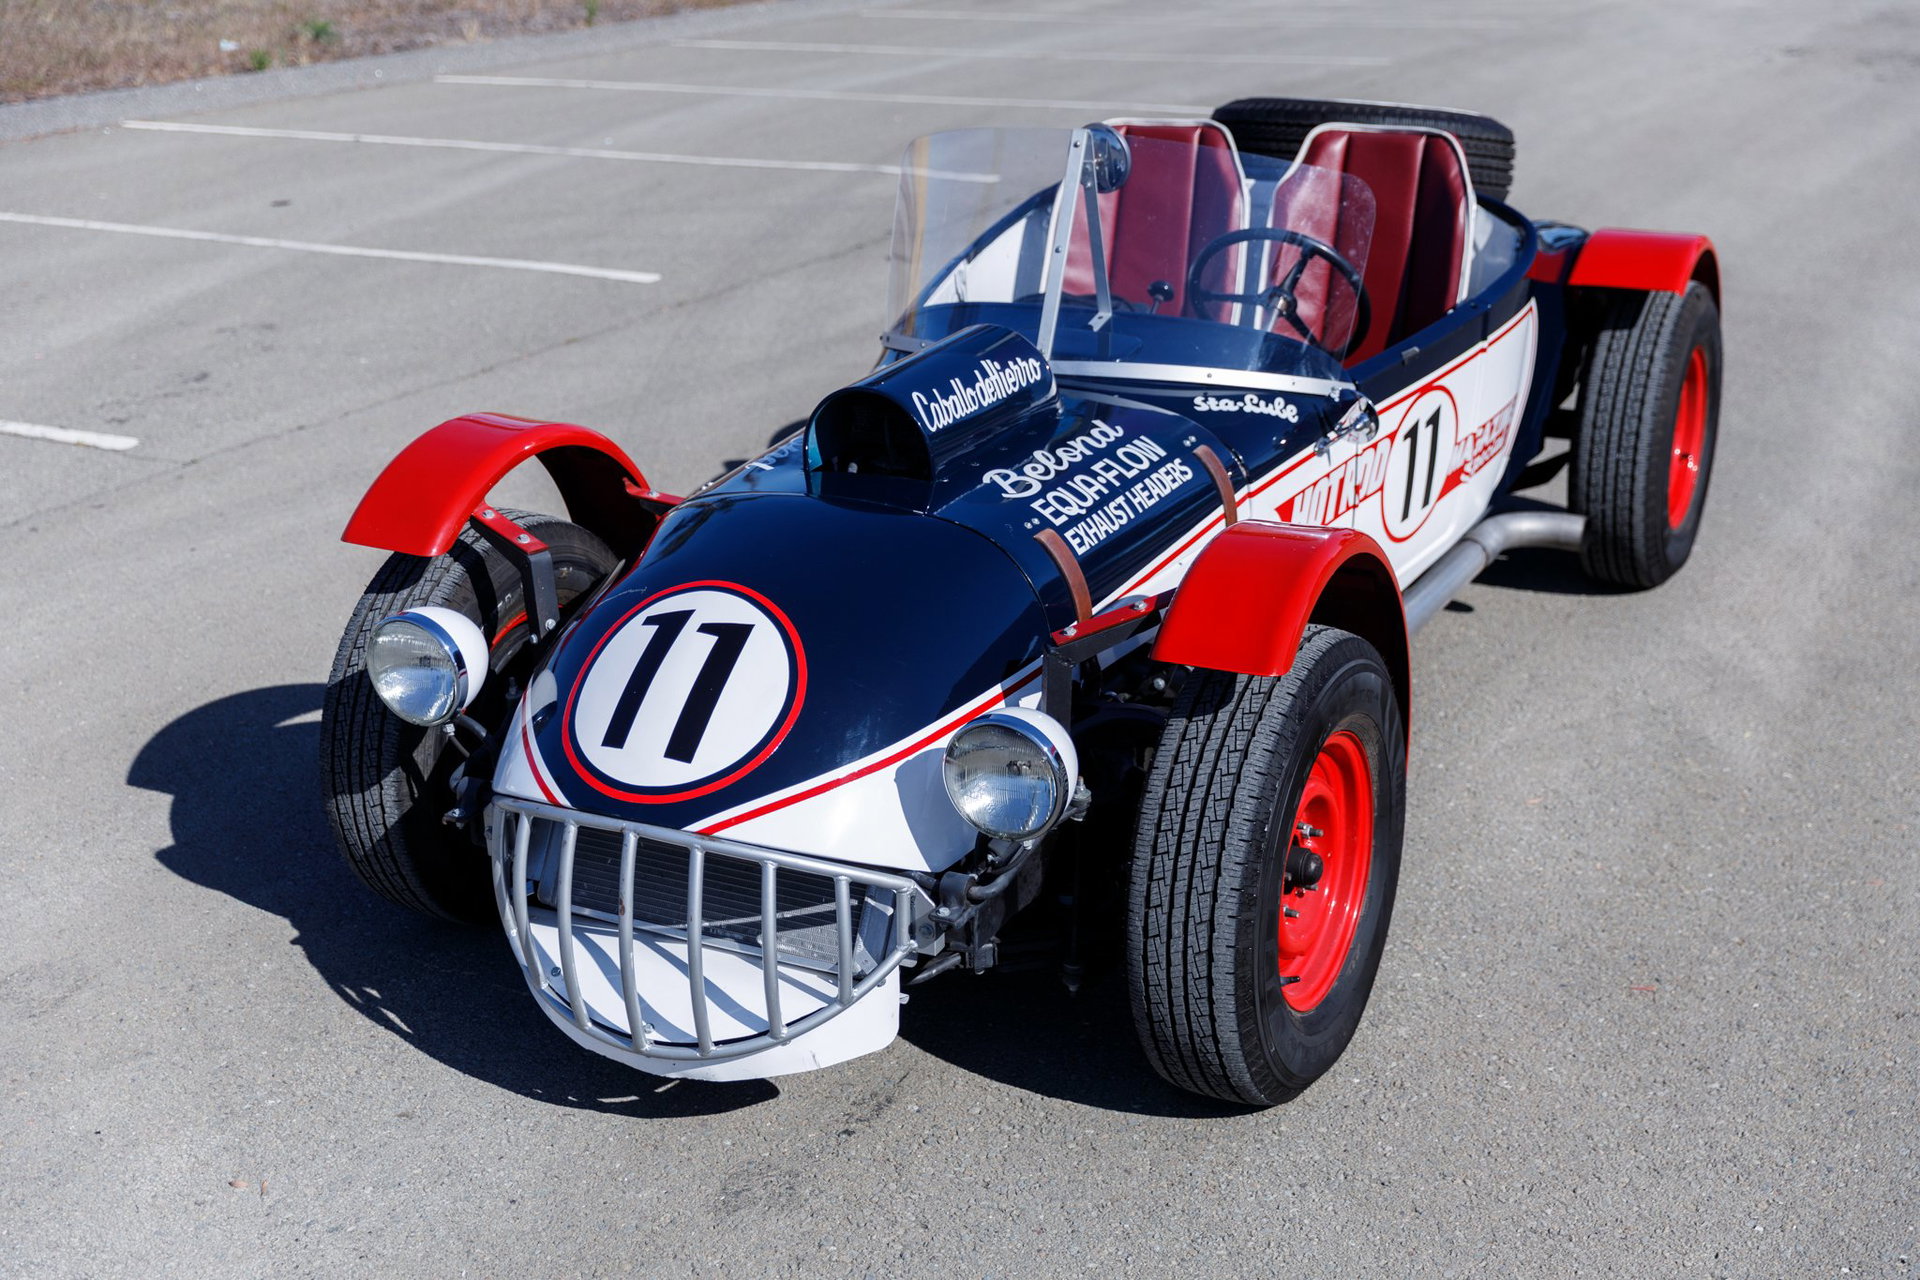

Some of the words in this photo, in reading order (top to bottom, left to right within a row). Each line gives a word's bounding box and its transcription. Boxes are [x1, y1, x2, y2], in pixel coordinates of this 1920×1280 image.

[1193, 394, 1299, 423] Sta-Lube
[982, 419, 1124, 498] Belond
[1064, 496, 1136, 556] EXHAUST
[1125, 457, 1194, 514] HEADERS
[1400, 404, 1442, 523] 11
[600, 609, 756, 764] 11
